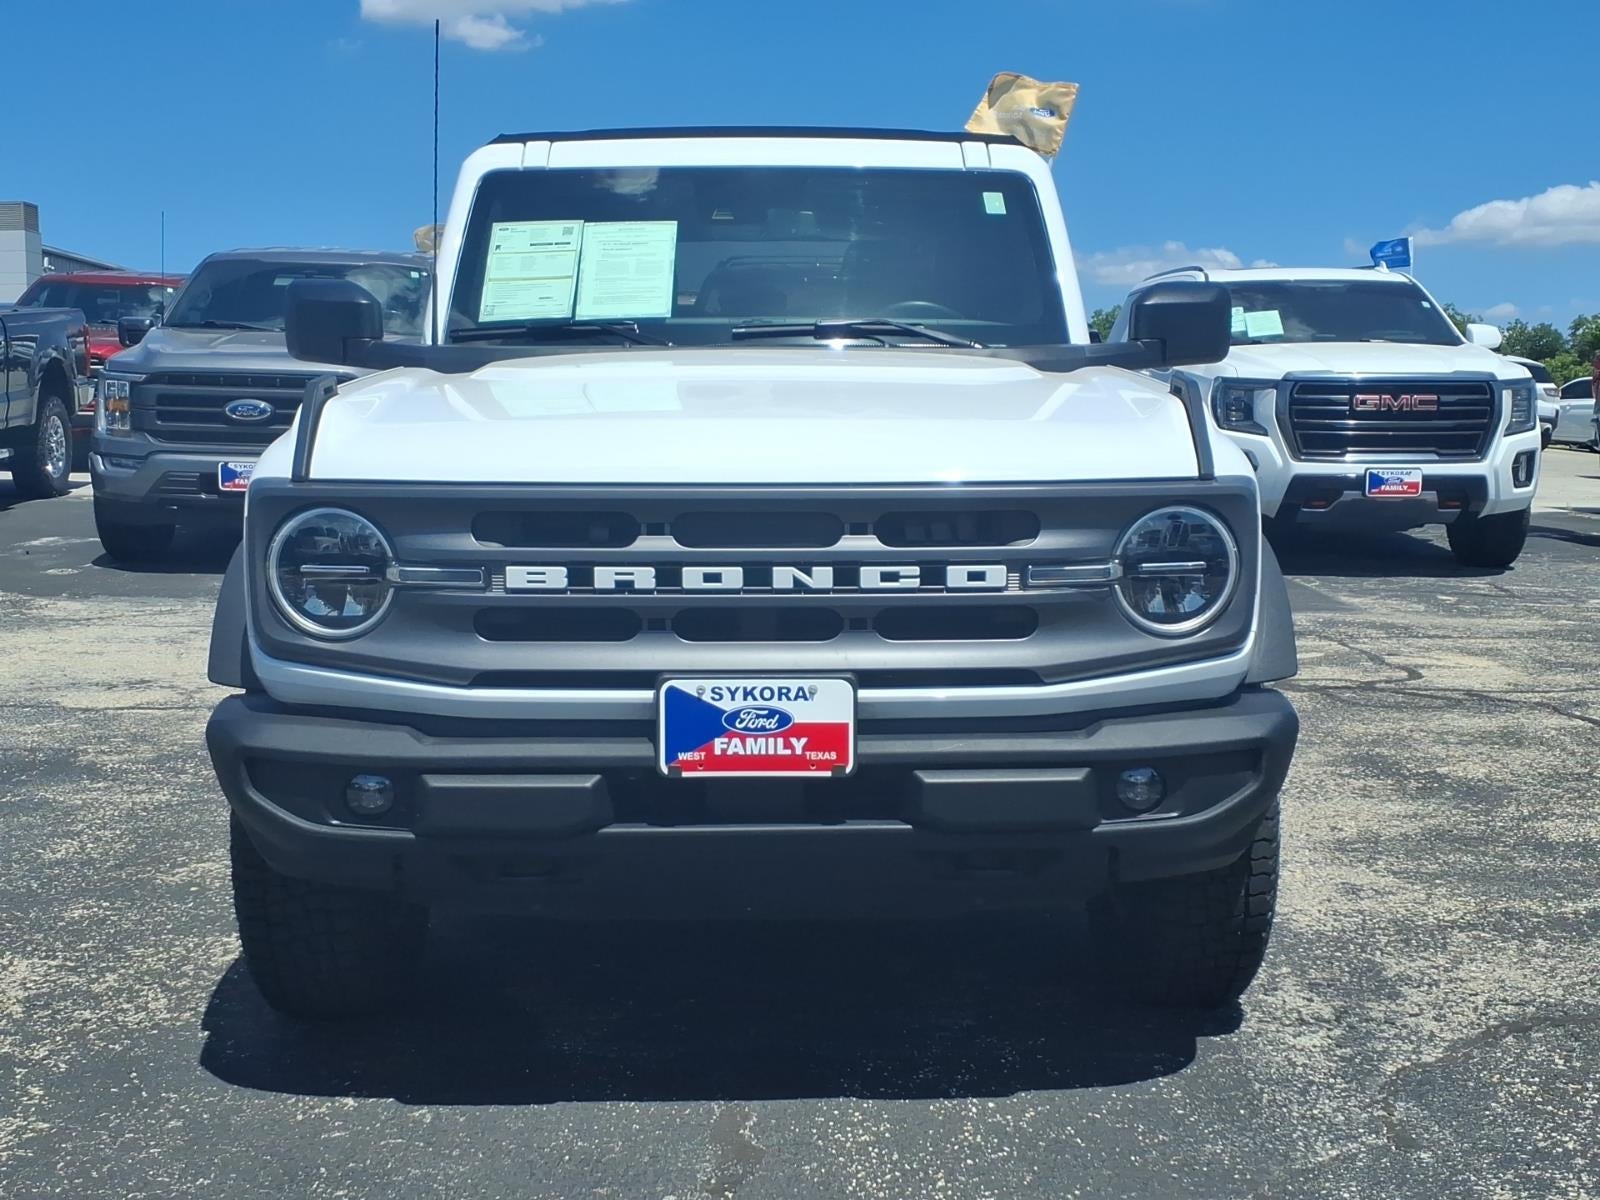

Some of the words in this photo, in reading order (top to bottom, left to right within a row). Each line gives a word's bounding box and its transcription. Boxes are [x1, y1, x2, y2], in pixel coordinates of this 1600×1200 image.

[235, 406, 260, 416] Ford
[1353, 394, 1438, 411] GMC
[505, 565, 1008, 590] BRONCO
[710, 686, 810, 702] SYKORA
[735, 708, 779, 730] Ford
[714, 737, 808, 755] FAMILY
[678, 752, 706, 760] WEST
[805, 752, 837, 760] TEXAS
